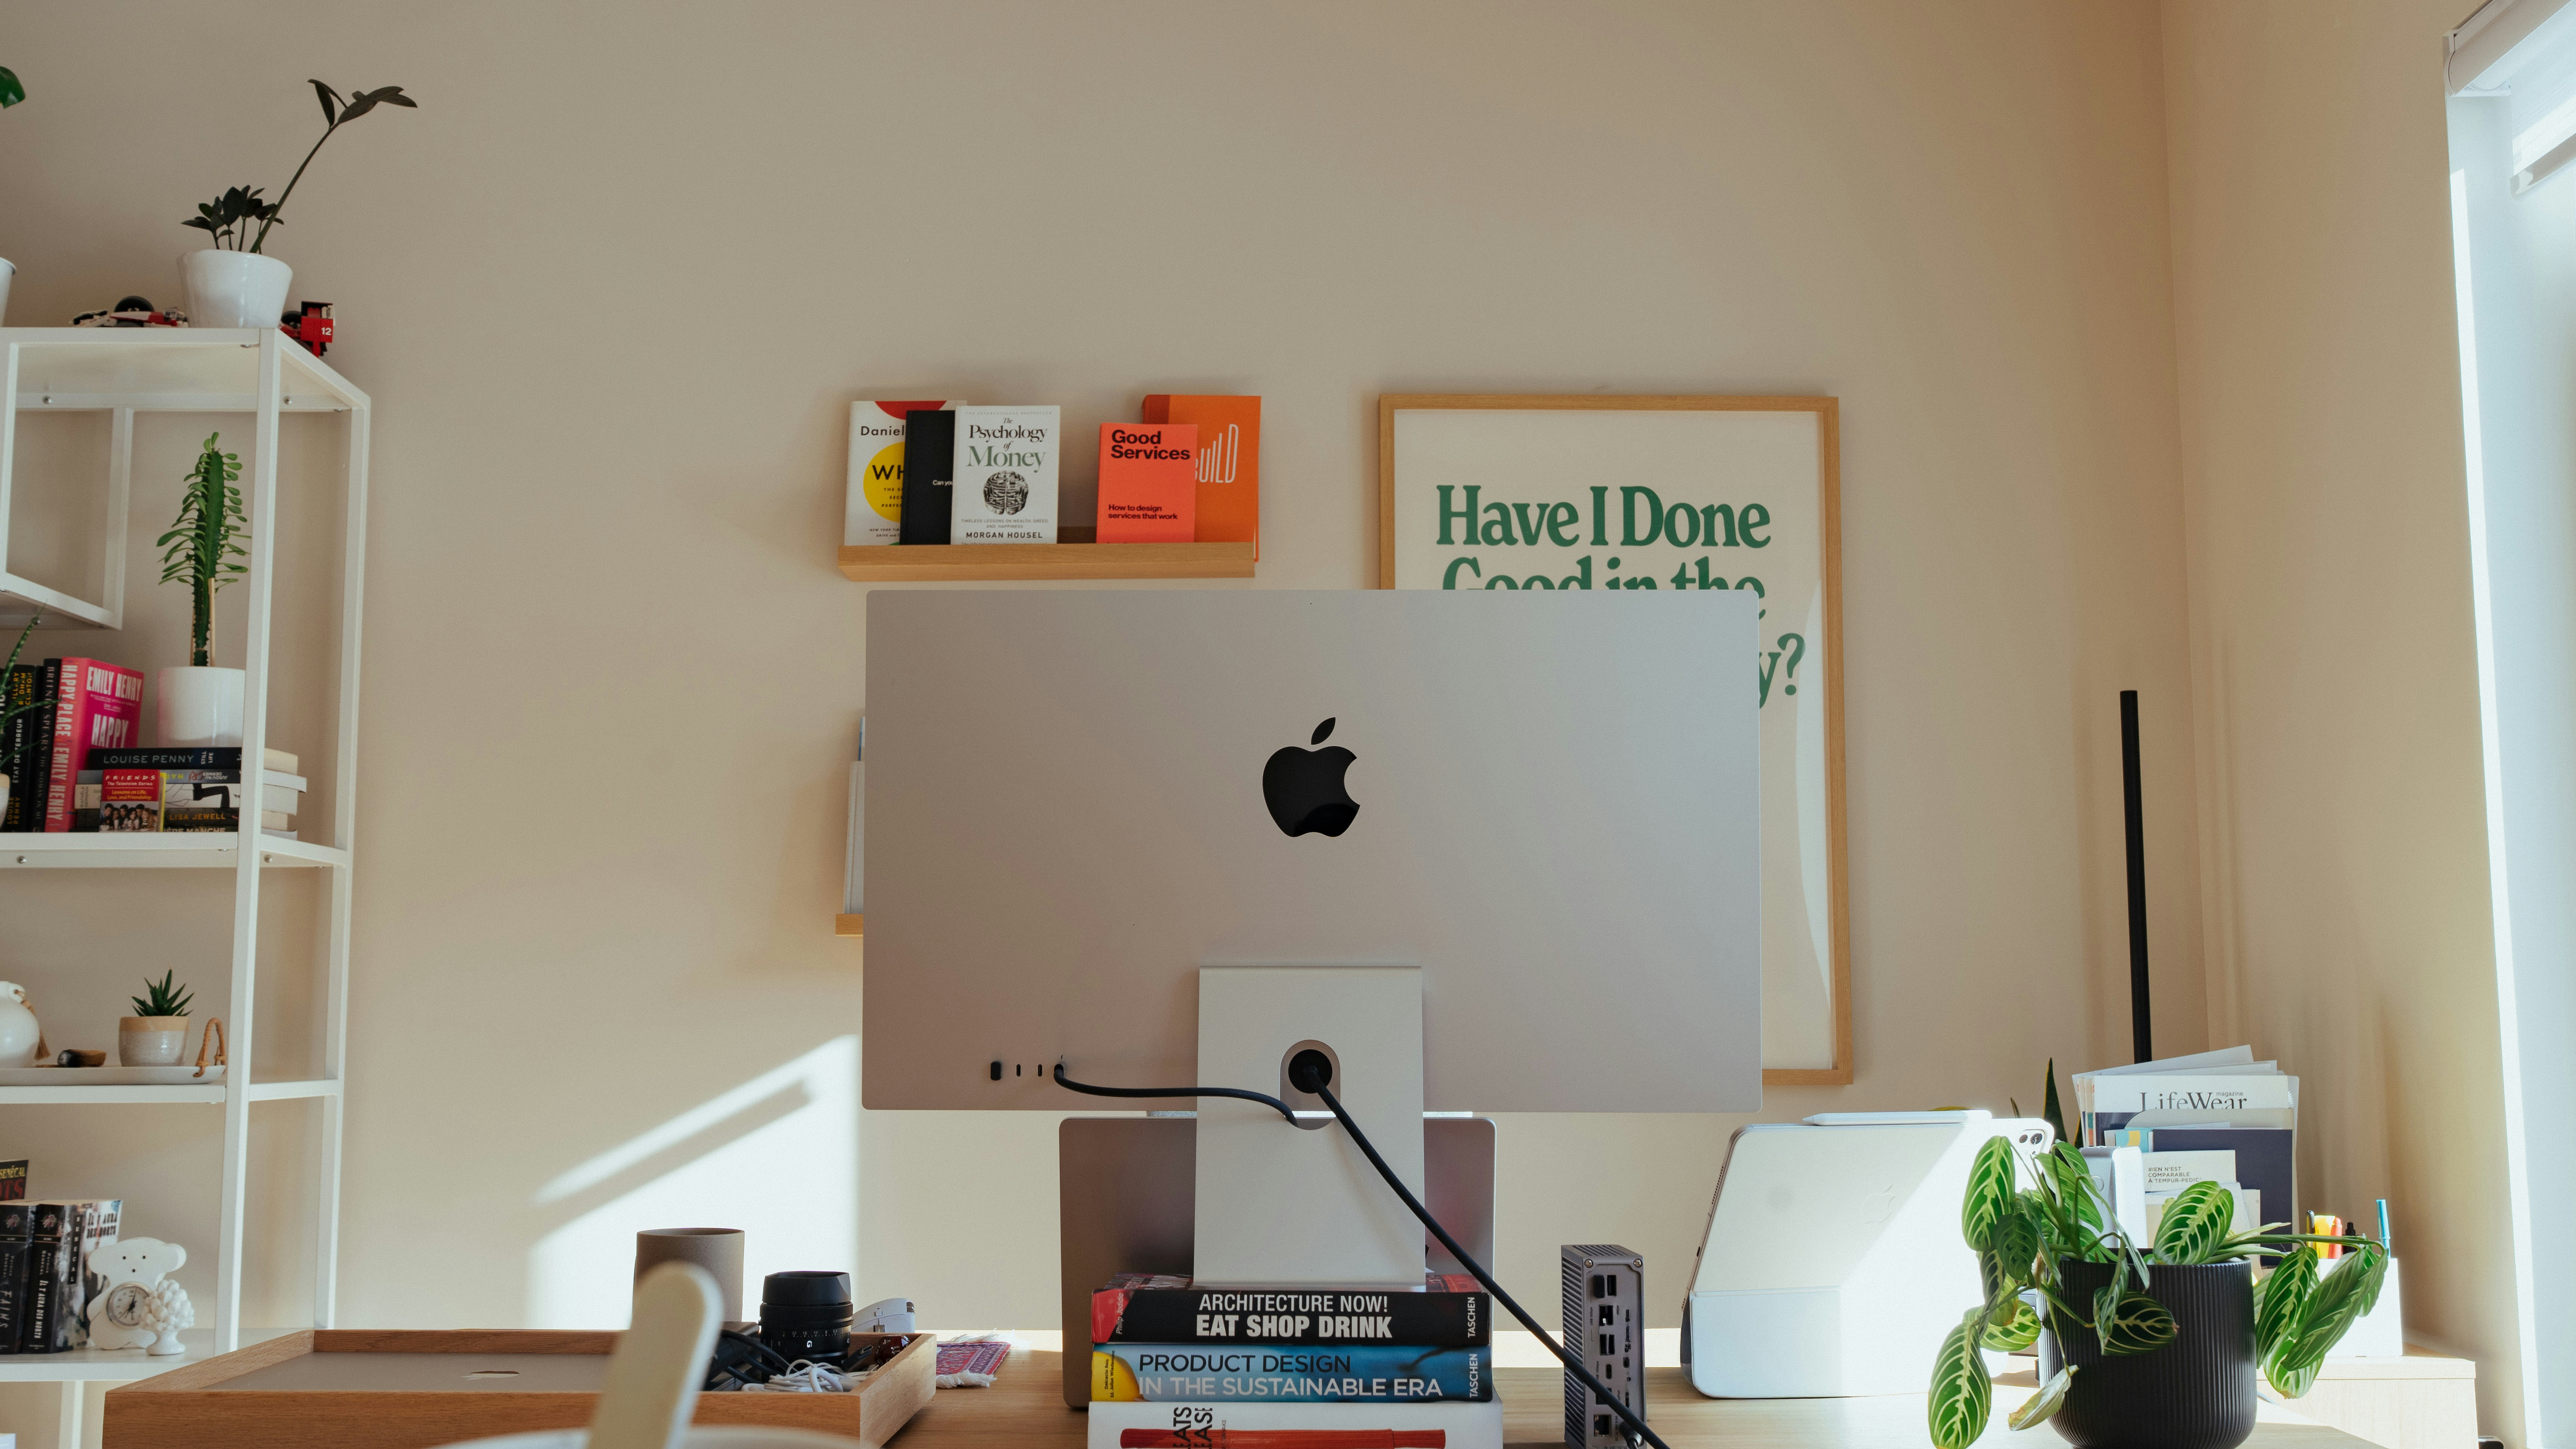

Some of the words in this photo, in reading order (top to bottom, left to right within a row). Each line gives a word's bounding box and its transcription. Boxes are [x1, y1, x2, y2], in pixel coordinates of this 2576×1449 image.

[321, 327, 332, 336] 12
[861, 426, 905, 436] Daniel
[969, 425, 1047, 443] Psychology
[1111, 429, 1161, 444] Good
[1003, 441, 1014, 451] of
[1111, 445, 1190, 460] Services
[1195, 424, 1239, 483] UILD
[966, 446, 1047, 473] Money
[1136, 505, 1162, 513] design
[1436, 485, 1580, 546] Have
[1590, 486, 1608, 546] I
[1619, 486, 1771, 548] Done
[61, 665, 78, 700] HAPPY
[86, 666, 114, 695] EMILY
[115, 673, 142, 702] HENRY
[55, 703, 74, 737] PLACE
[40, 714, 50, 751] SPEARS
[91, 713, 129, 748] HAPPY
[14, 754, 20, 763] DE
[52, 747, 70, 781] EMILY
[188, 770, 205, 781] CRI
[46, 785, 65, 821] HENRY
[2140, 1092, 2247, 1112] LifeWear
[0, 1291, 13, 1328] FAIMS
[1199, 1294, 1333, 1312] ARCHITECTURE
[1340, 1296, 1388, 1313] NOW!
[36, 1310, 44, 1320] DES
[34, 1321, 43, 1339] MORTS
[1116, 1316, 1124, 1335] Philip
[1196, 1314, 1238, 1336] EAT
[1246, 1314, 1310, 1337] SHOP
[1318, 1316, 1393, 1338] DRINK
[1139, 1354, 1256, 1372] PRODUCT
[1263, 1355, 1351, 1373] DESIGN
[1469, 1353, 1477, 1398] TASCHEN
[1139, 1377, 1161, 1395] IN
[1170, 1377, 1216, 1395] THE
[1222, 1377, 1387, 1397] SUSTAINABLE
[1394, 1378, 1443, 1397] ERA
[1173, 1407, 1192, 1449] EATS
[1194, 1408, 1213, 1449] EASE
